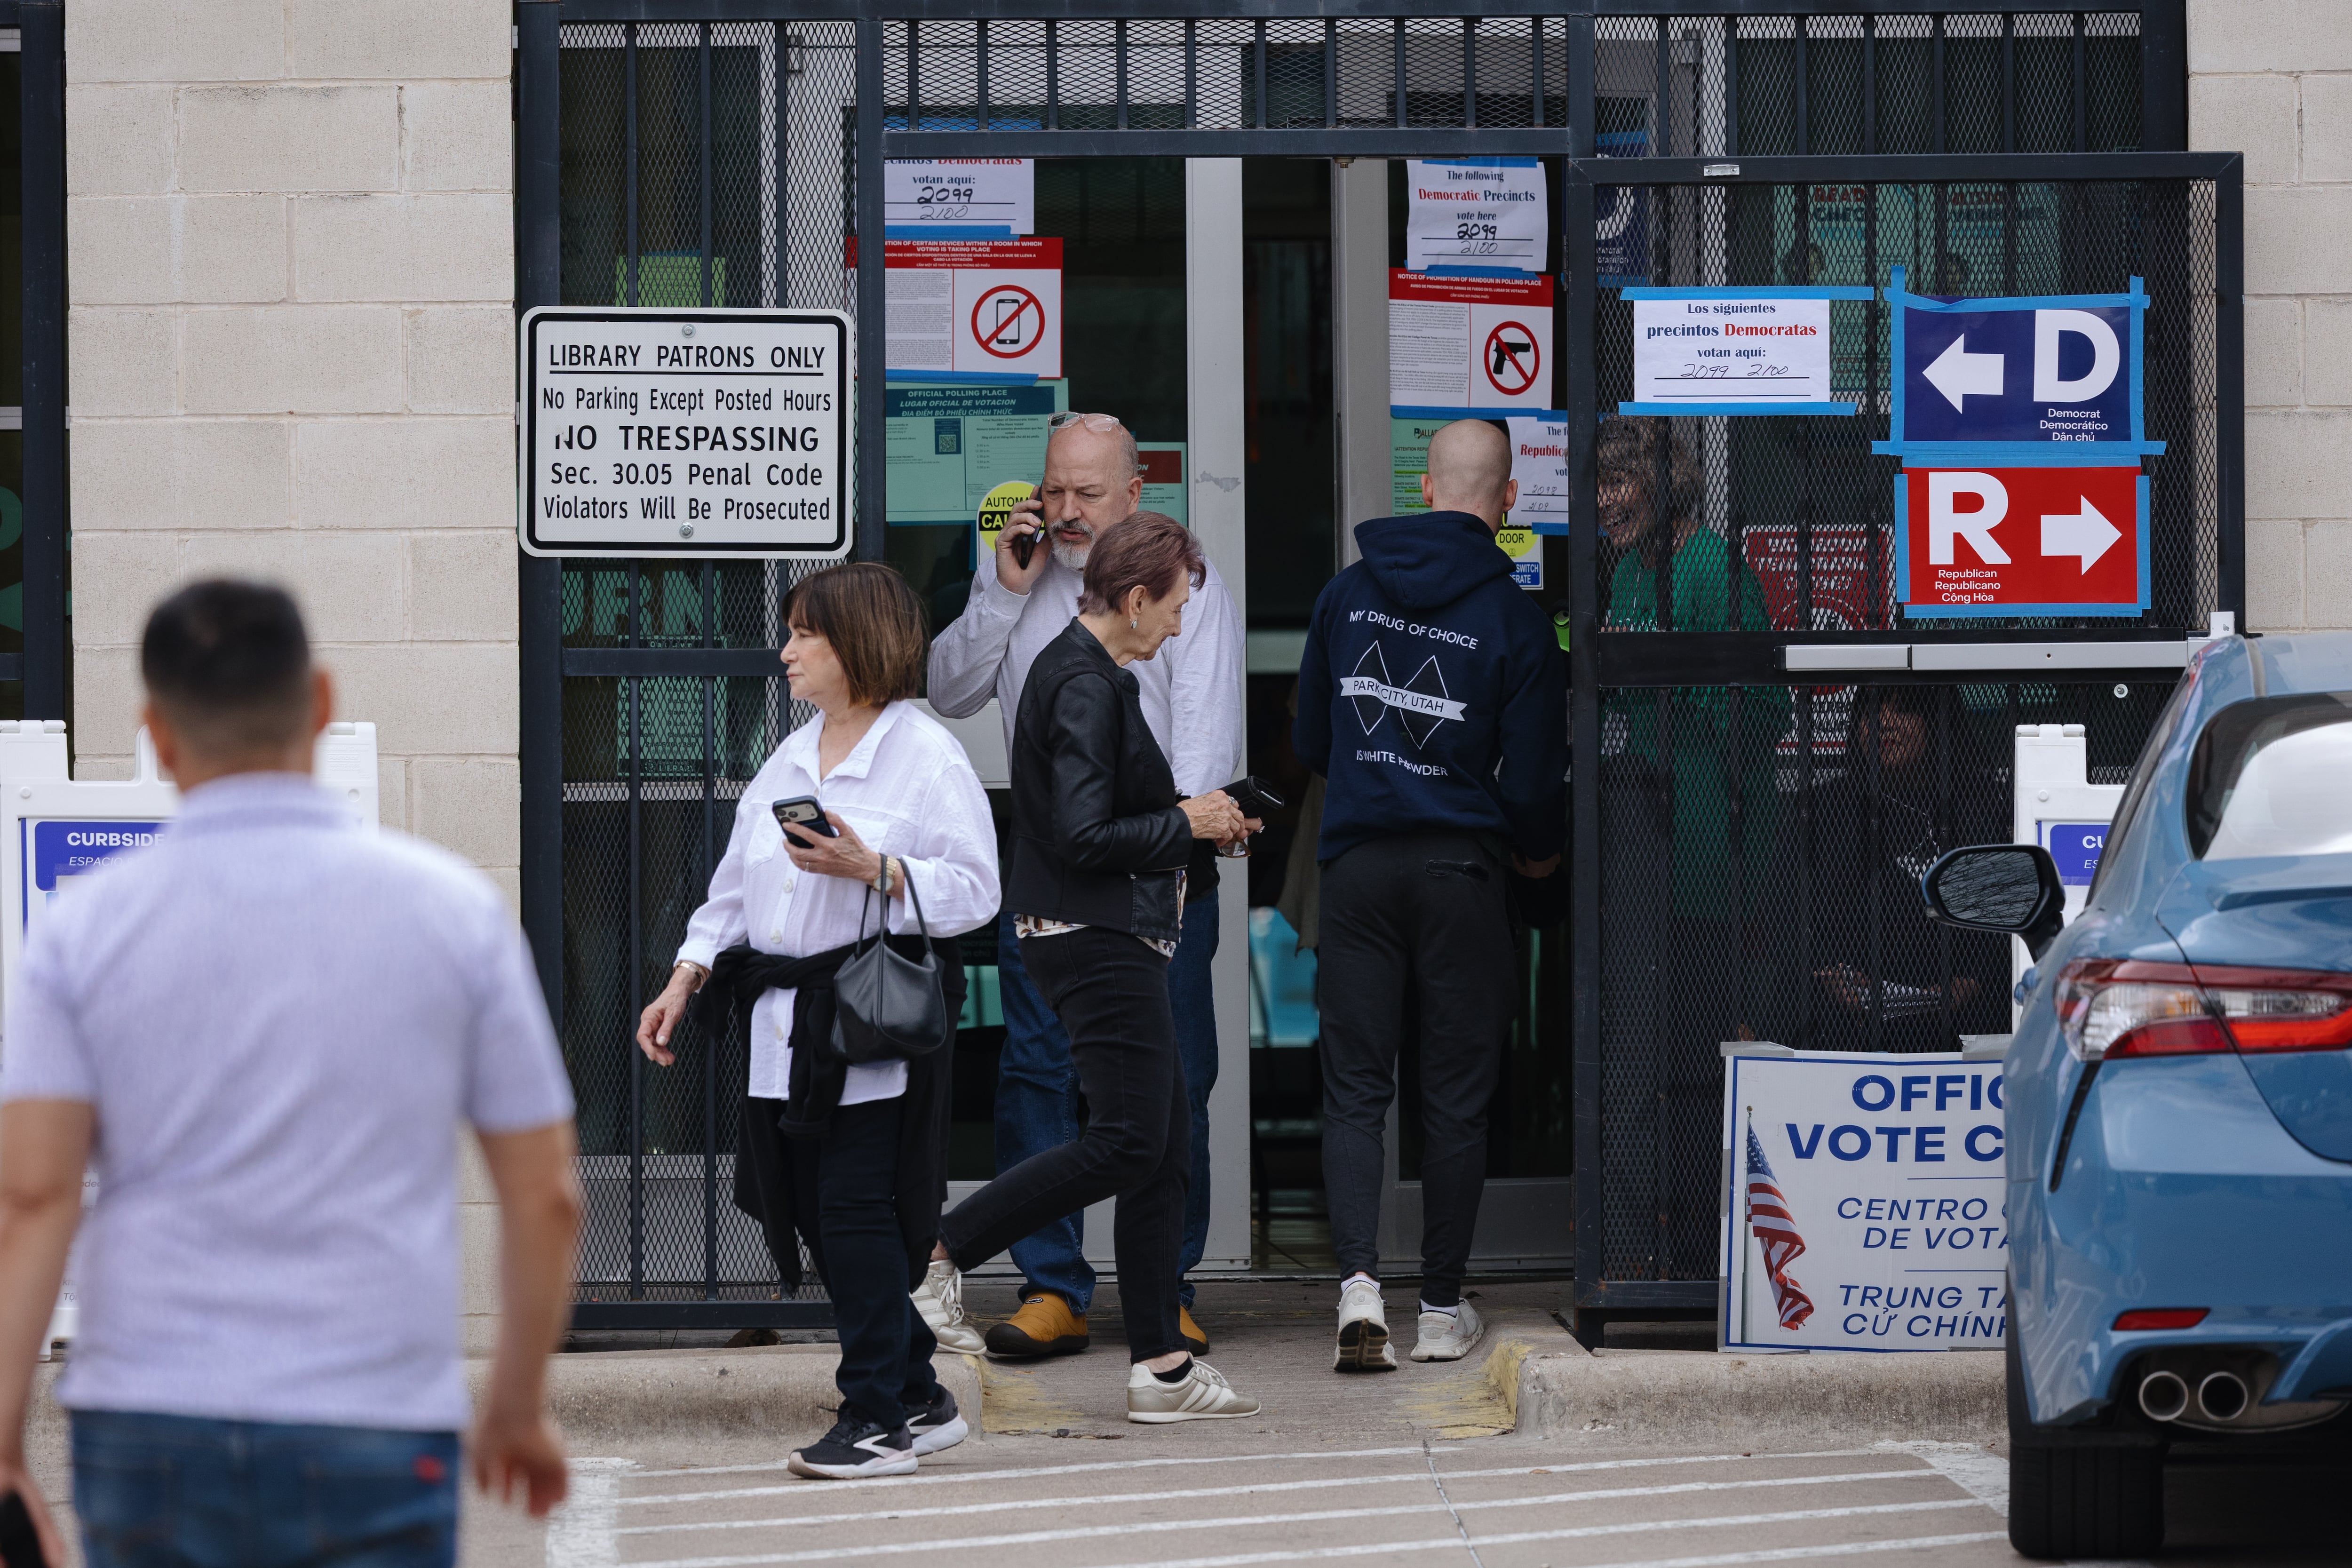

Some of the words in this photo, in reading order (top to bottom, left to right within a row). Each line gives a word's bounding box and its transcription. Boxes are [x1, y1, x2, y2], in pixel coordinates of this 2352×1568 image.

[913, 175, 943, 184] votan
[947, 175, 976, 187] aquí:
[1447, 170, 1462, 180] The
[1465, 171, 1504, 183] following
[917, 186, 973, 204] 2099
[1419, 189, 1480, 201] Democratic
[1484, 190, 1535, 201] Precincts
[920, 206, 968, 219] 2100
[1478, 211, 1496, 220] here
[1457, 223, 1497, 240] 2099
[1461, 240, 1498, 254] 2100
[1688, 303, 1709, 314] Los
[1713, 303, 1776, 316] siguientes
[1647, 324, 1719, 339] precintos
[1725, 324, 1817, 336] Democratas
[550, 344, 641, 366] LIBRARY
[657, 345, 754, 367] PATRONS
[771, 346, 825, 368] ONLY
[1697, 348, 1731, 358] votan
[1735, 347, 1766, 359] aquí:
[2033, 309, 2120, 403] D
[1681, 364, 1728, 379] 2099
[1747, 364, 1788, 376] 2100
[543, 387, 564, 409] No
[576, 386, 638, 416] Parking
[650, 388, 704, 416] Except
[715, 388, 771, 411] Posted
[784, 390, 831, 411] Hours
[2048, 408, 2100, 418] Democrat
[1547, 426, 1561, 436] The
[2040, 420, 2108, 430] Democrático
[555, 425, 597, 450] NO
[619, 426, 819, 451] TRESPASSING
[2052, 432, 2073, 441] Dân
[2075, 431, 2095, 442] chủ
[551, 462, 597, 485] Sec.
[612, 463, 672, 485] 30.05
[689, 462, 751, 486] Penal
[767, 462, 822, 486] Code
[543, 494, 628, 519] Violators
[640, 495, 675, 519] Will
[689, 498, 711, 520] Be
[724, 497, 829, 520] Prosecuted
[1928, 471, 2011, 565] R
[1500, 533, 1524, 543] DOOR
[1516, 564, 1539, 573] SWITCH
[1938, 569, 1997, 581] Republican
[1935, 581, 2001, 592] Republicano
[1941, 592, 1971, 604] Cộng
[1973, 592, 1994, 601] Hòa
[1349, 610, 1365, 622] MY
[1367, 611, 1405, 631] DRUG
[1409, 623, 1427, 637] OF
[1428, 628, 1478, 650] CHOICE
[1354, 680, 1380, 694] PARK
[1381, 688, 1407, 706] CITY,
[1412, 696, 1444, 713] UTAH
[1357, 750, 1363, 761] IS
[1364, 751, 1395, 764] WHITE
[1785, 1123, 1945, 1162] VOTE
[1837, 1197, 1988, 1221] CENTRO
[1863, 1227, 1910, 1249] DE
[1839, 1285, 1962, 1309] TRUNG
